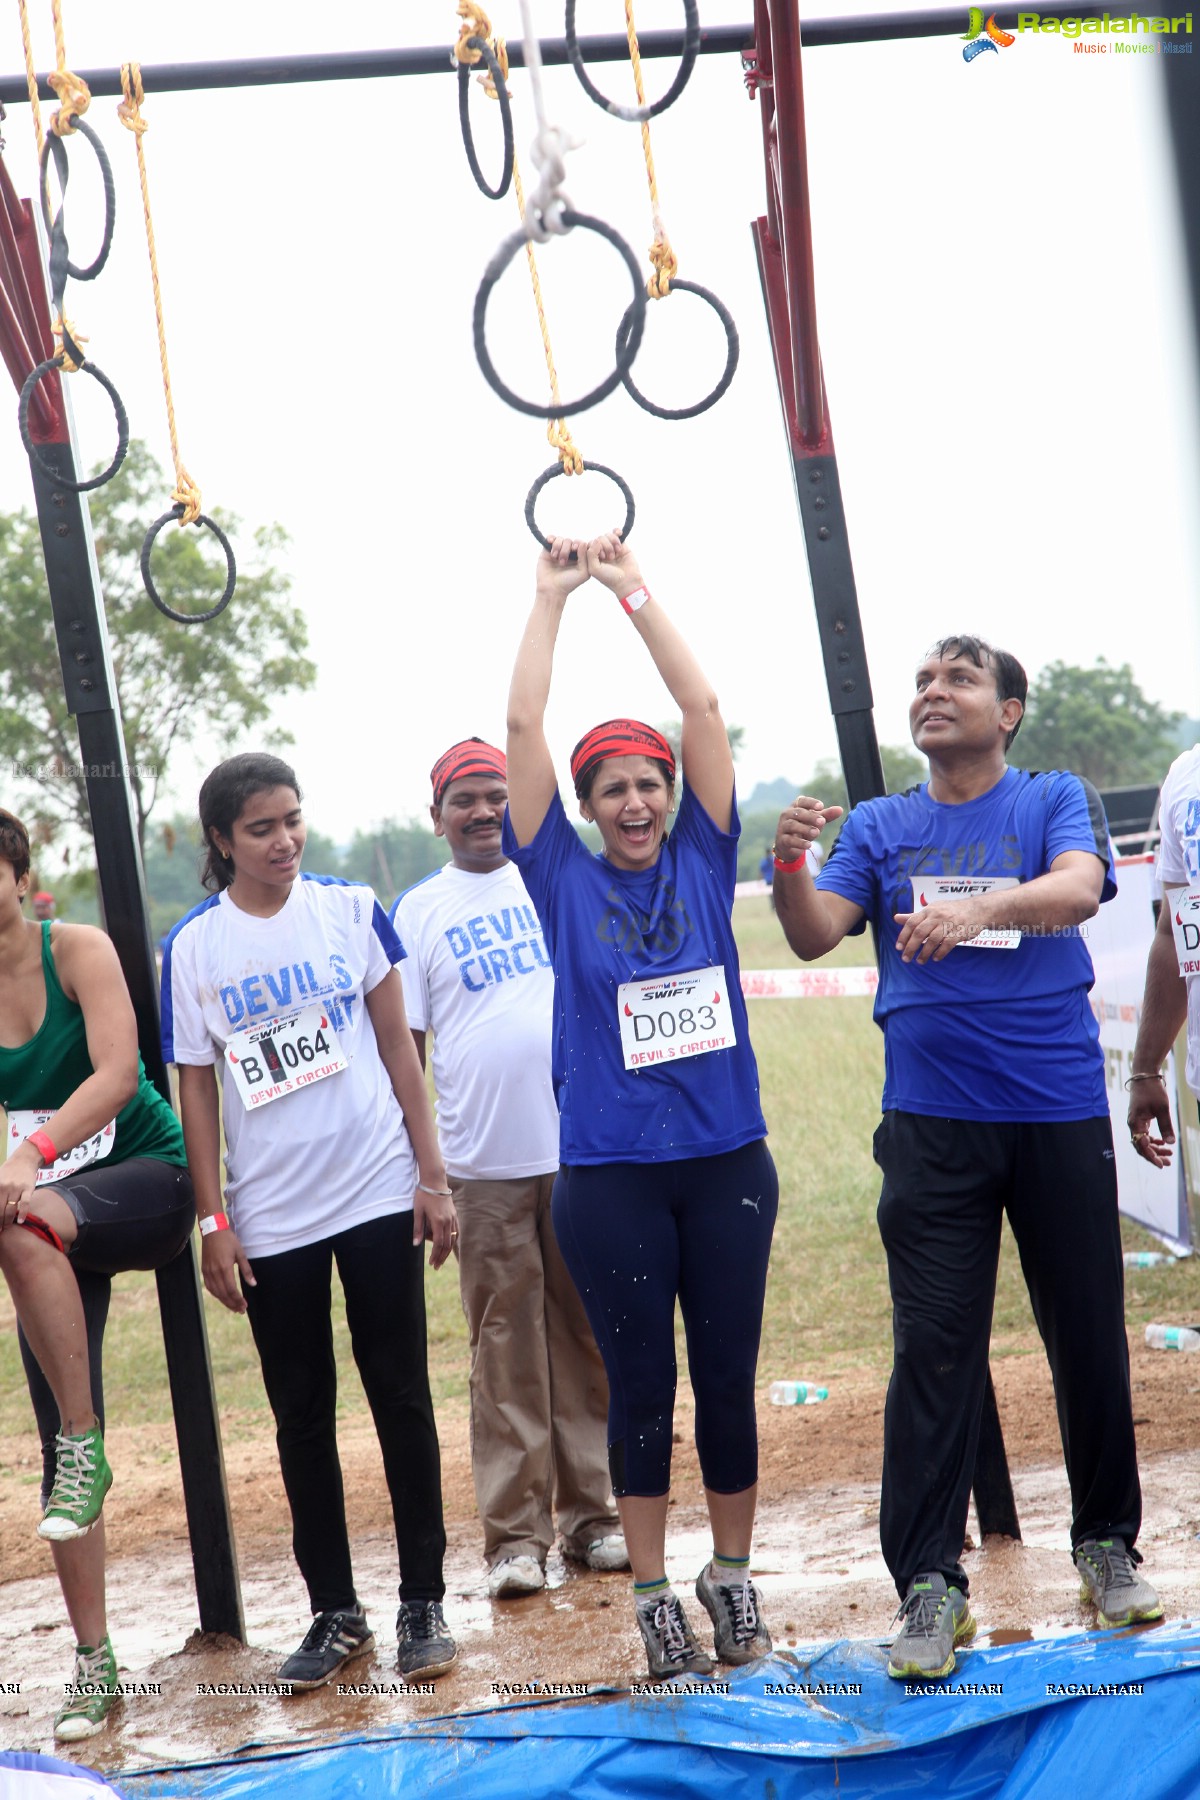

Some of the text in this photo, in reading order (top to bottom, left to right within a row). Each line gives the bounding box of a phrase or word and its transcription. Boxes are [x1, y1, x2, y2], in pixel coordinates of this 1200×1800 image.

[938, 885, 992, 893] SWIFT
[219, 954, 352, 1024] DEVILS
[641, 986, 696, 1001] SWIFT
[249, 1018, 299, 1044] SWIFT
[633, 1005, 717, 1042] D083
[281, 1028, 330, 1069] 064
[630, 1037, 726, 1066] DEVILS CIRCUIT
[250, 1081, 294, 1105] DEVILS
[296, 1061, 340, 1086] CIRCUIT
